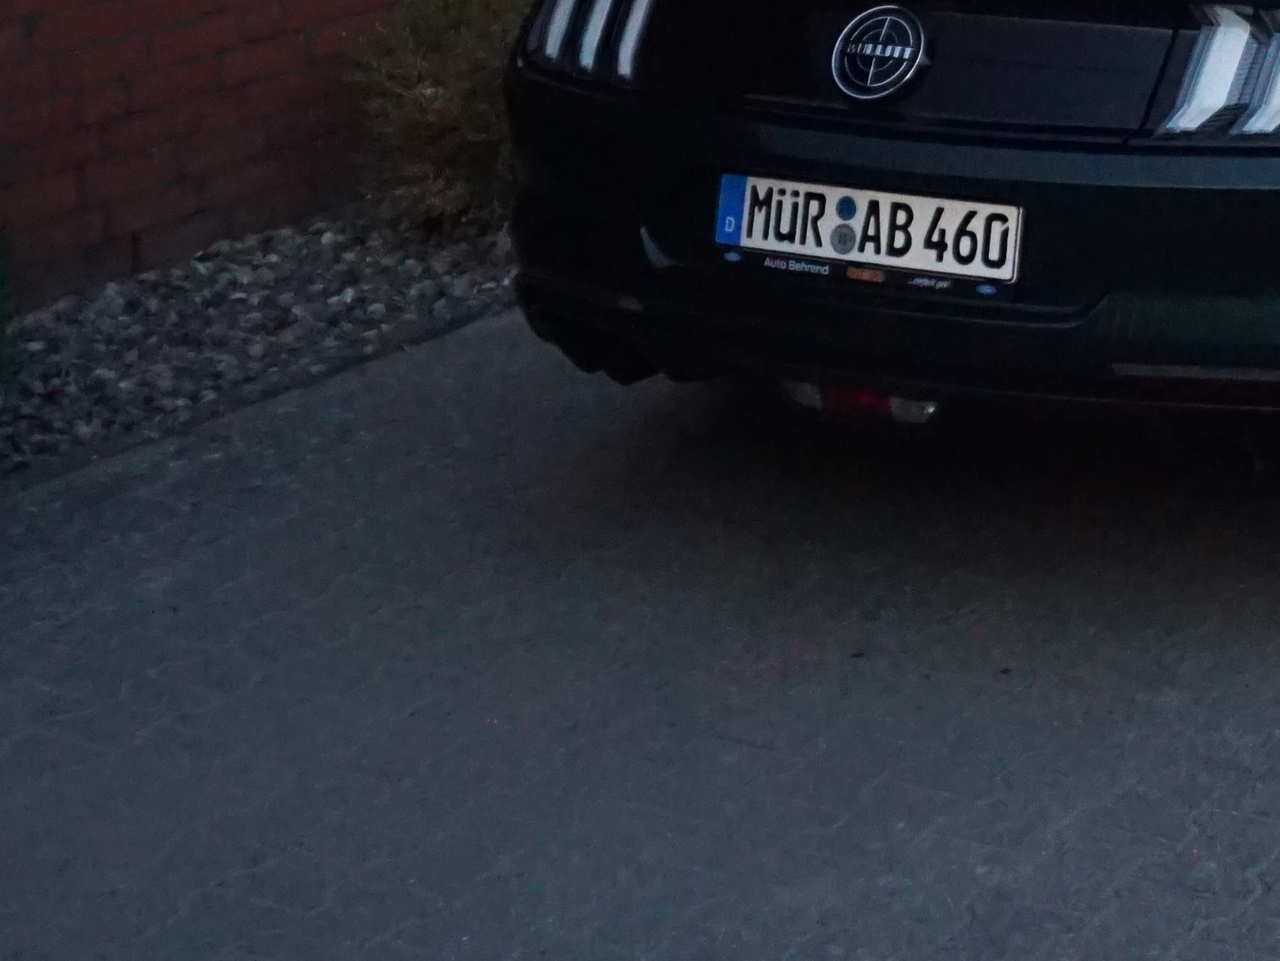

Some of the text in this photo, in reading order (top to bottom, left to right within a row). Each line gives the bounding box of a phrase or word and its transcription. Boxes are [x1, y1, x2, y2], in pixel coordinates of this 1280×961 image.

[725, 216, 735, 232] D
[746, 184, 1009, 269] MÜR AB 460
[763, 256, 830, 275] Auto Behrend
